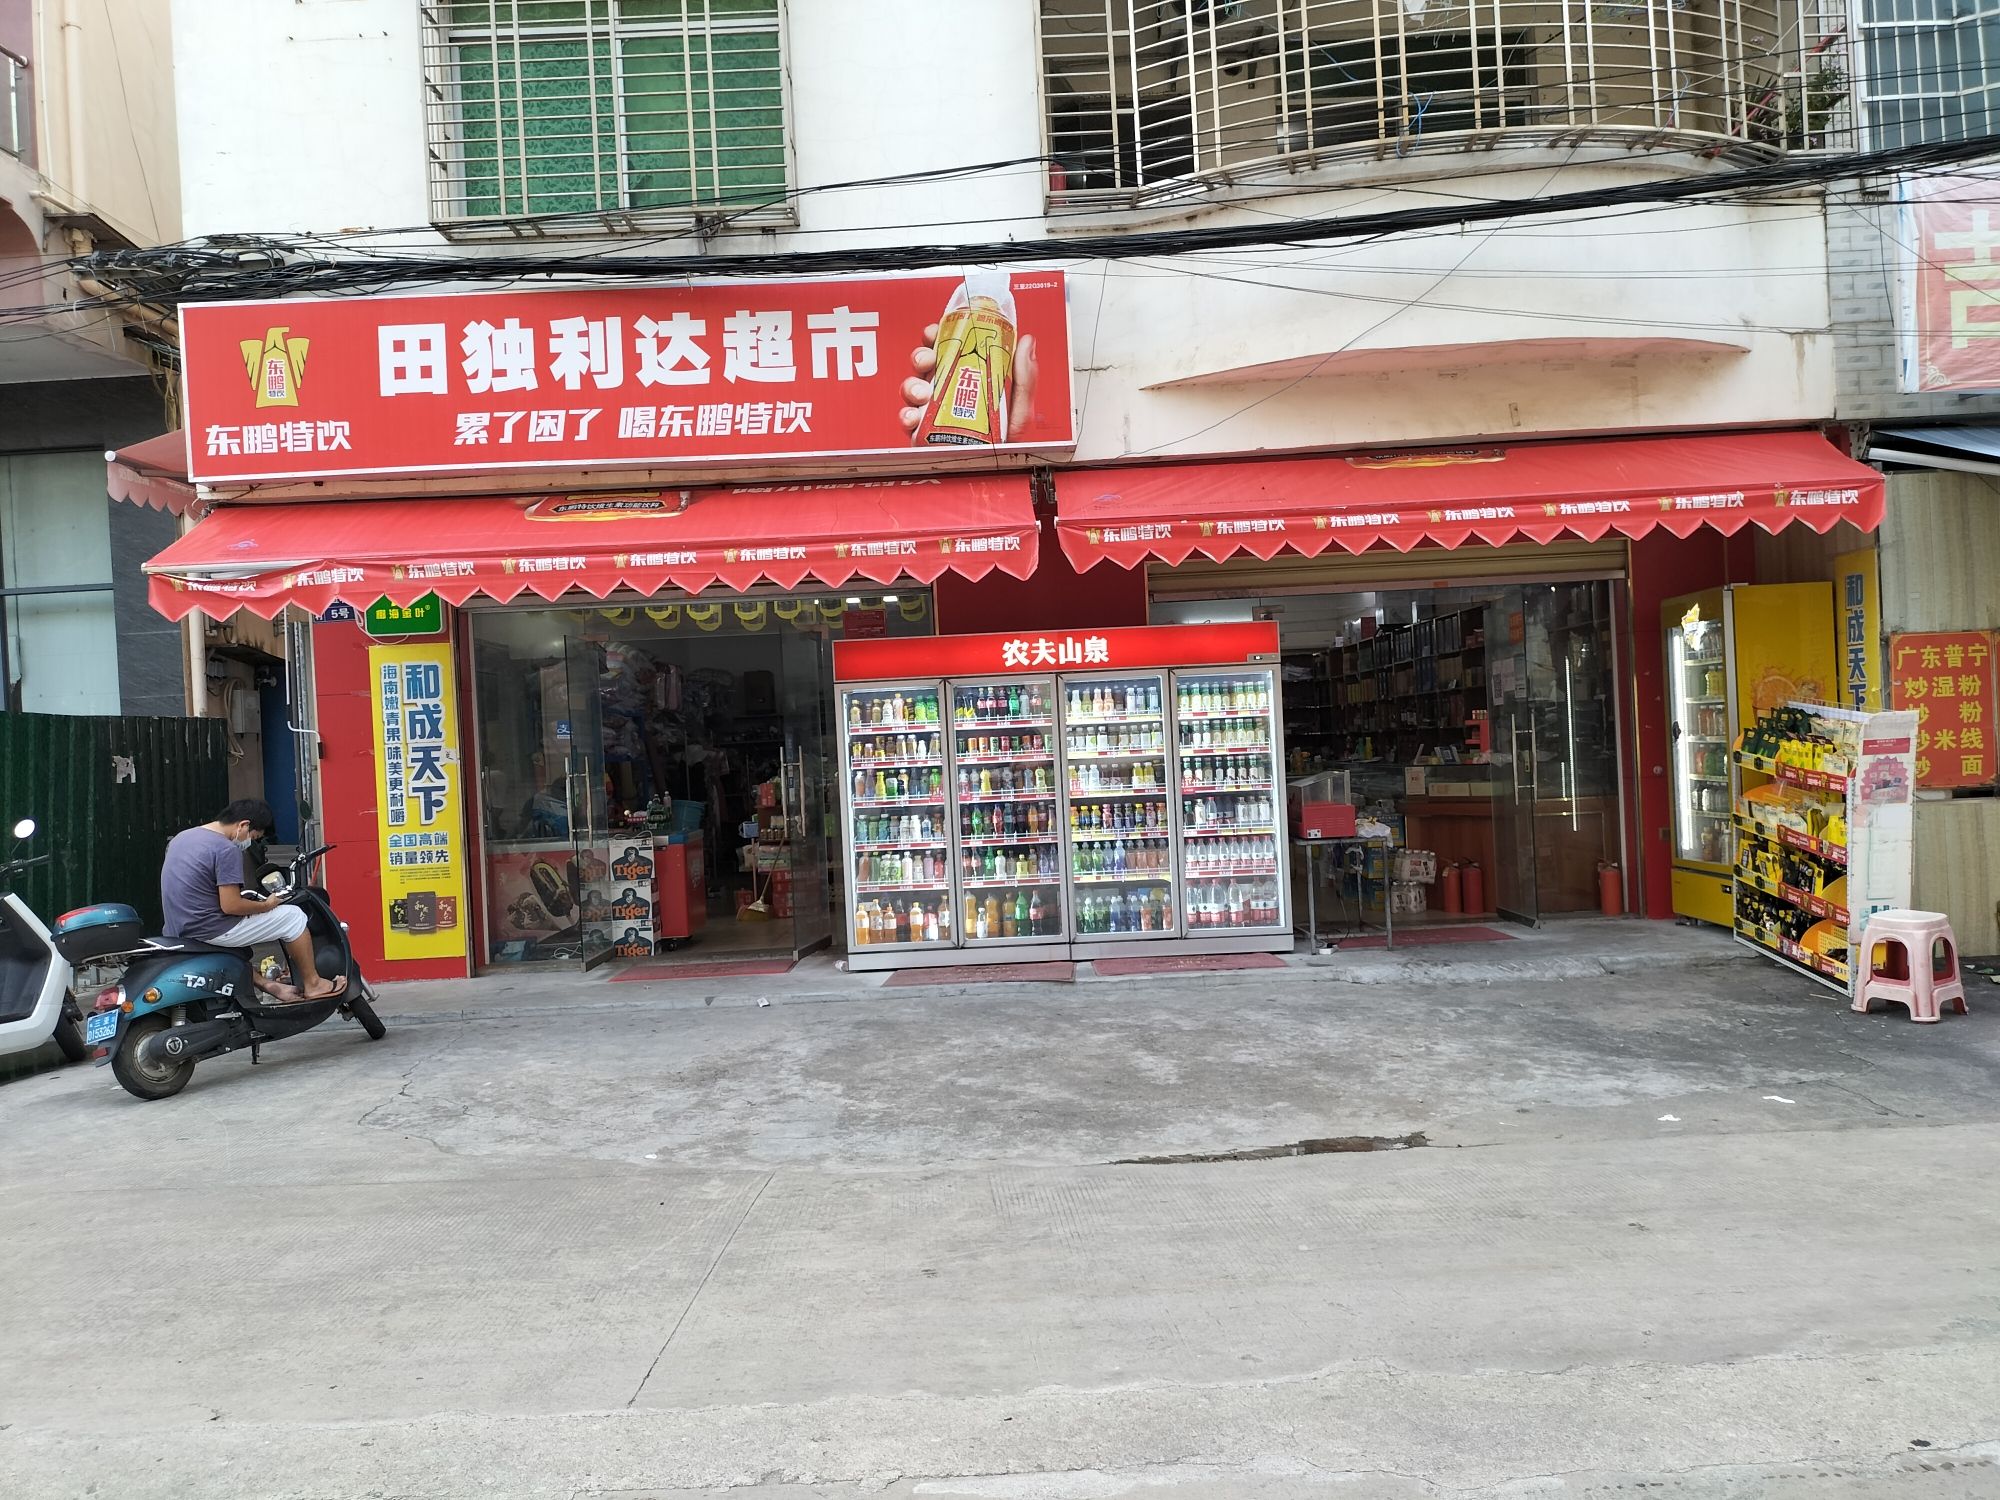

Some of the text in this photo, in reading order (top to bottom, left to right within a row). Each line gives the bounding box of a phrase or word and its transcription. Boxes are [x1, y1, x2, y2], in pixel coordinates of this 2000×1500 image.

[377, 306, 881, 398] 田独利达超市
[266, 359, 285, 390] 东鹏
[954, 367, 981, 408] 东鹏
[953, 407, 976, 419] 特饮
[454, 400, 813, 446] 累了困了 喝东鹏特饮
[205, 420, 353, 456] 东鹏特饮
[1675, 491, 1744, 509] 东鹏特饮
[1790, 489, 1859, 506] 东鹏特饮
[1445, 506, 1515, 521] 东鹏特饮
[1560, 500, 1631, 514] 东鹏特饮
[1216, 519, 1285, 536] 东鹏特饮
[1331, 513, 1400, 527] 东鹏特饮
[1103, 525, 1172, 543] 东鹏特饮
[850, 540, 917, 556] 东鹏特饮
[955, 536, 1020, 552] 东鹏特饮
[630, 551, 696, 567] 东鹏特饮
[740, 547, 806, 562] 东鹏特饮
[407, 561, 475, 579] 东鹏特饮
[519, 556, 586, 573] 东鹏特饮
[297, 567, 364, 585] 东鹏特饮
[331, 608, 349, 619] 5号
[1002, 636, 1110, 667] 农夫山泉
[1846, 574, 1867, 712] 和成天下
[1896, 643, 1988, 671] 广东普宁
[1904, 674, 1982, 700] 炒湿粉
[406, 663, 444, 822] 和成天下
[388, 832, 448, 849] 全国高端
[389, 850, 450, 865] 销量领先
[614, 863, 652, 880] Tiger
[613, 904, 649, 920] Tiger
[615, 942, 651, 957] Tiger
